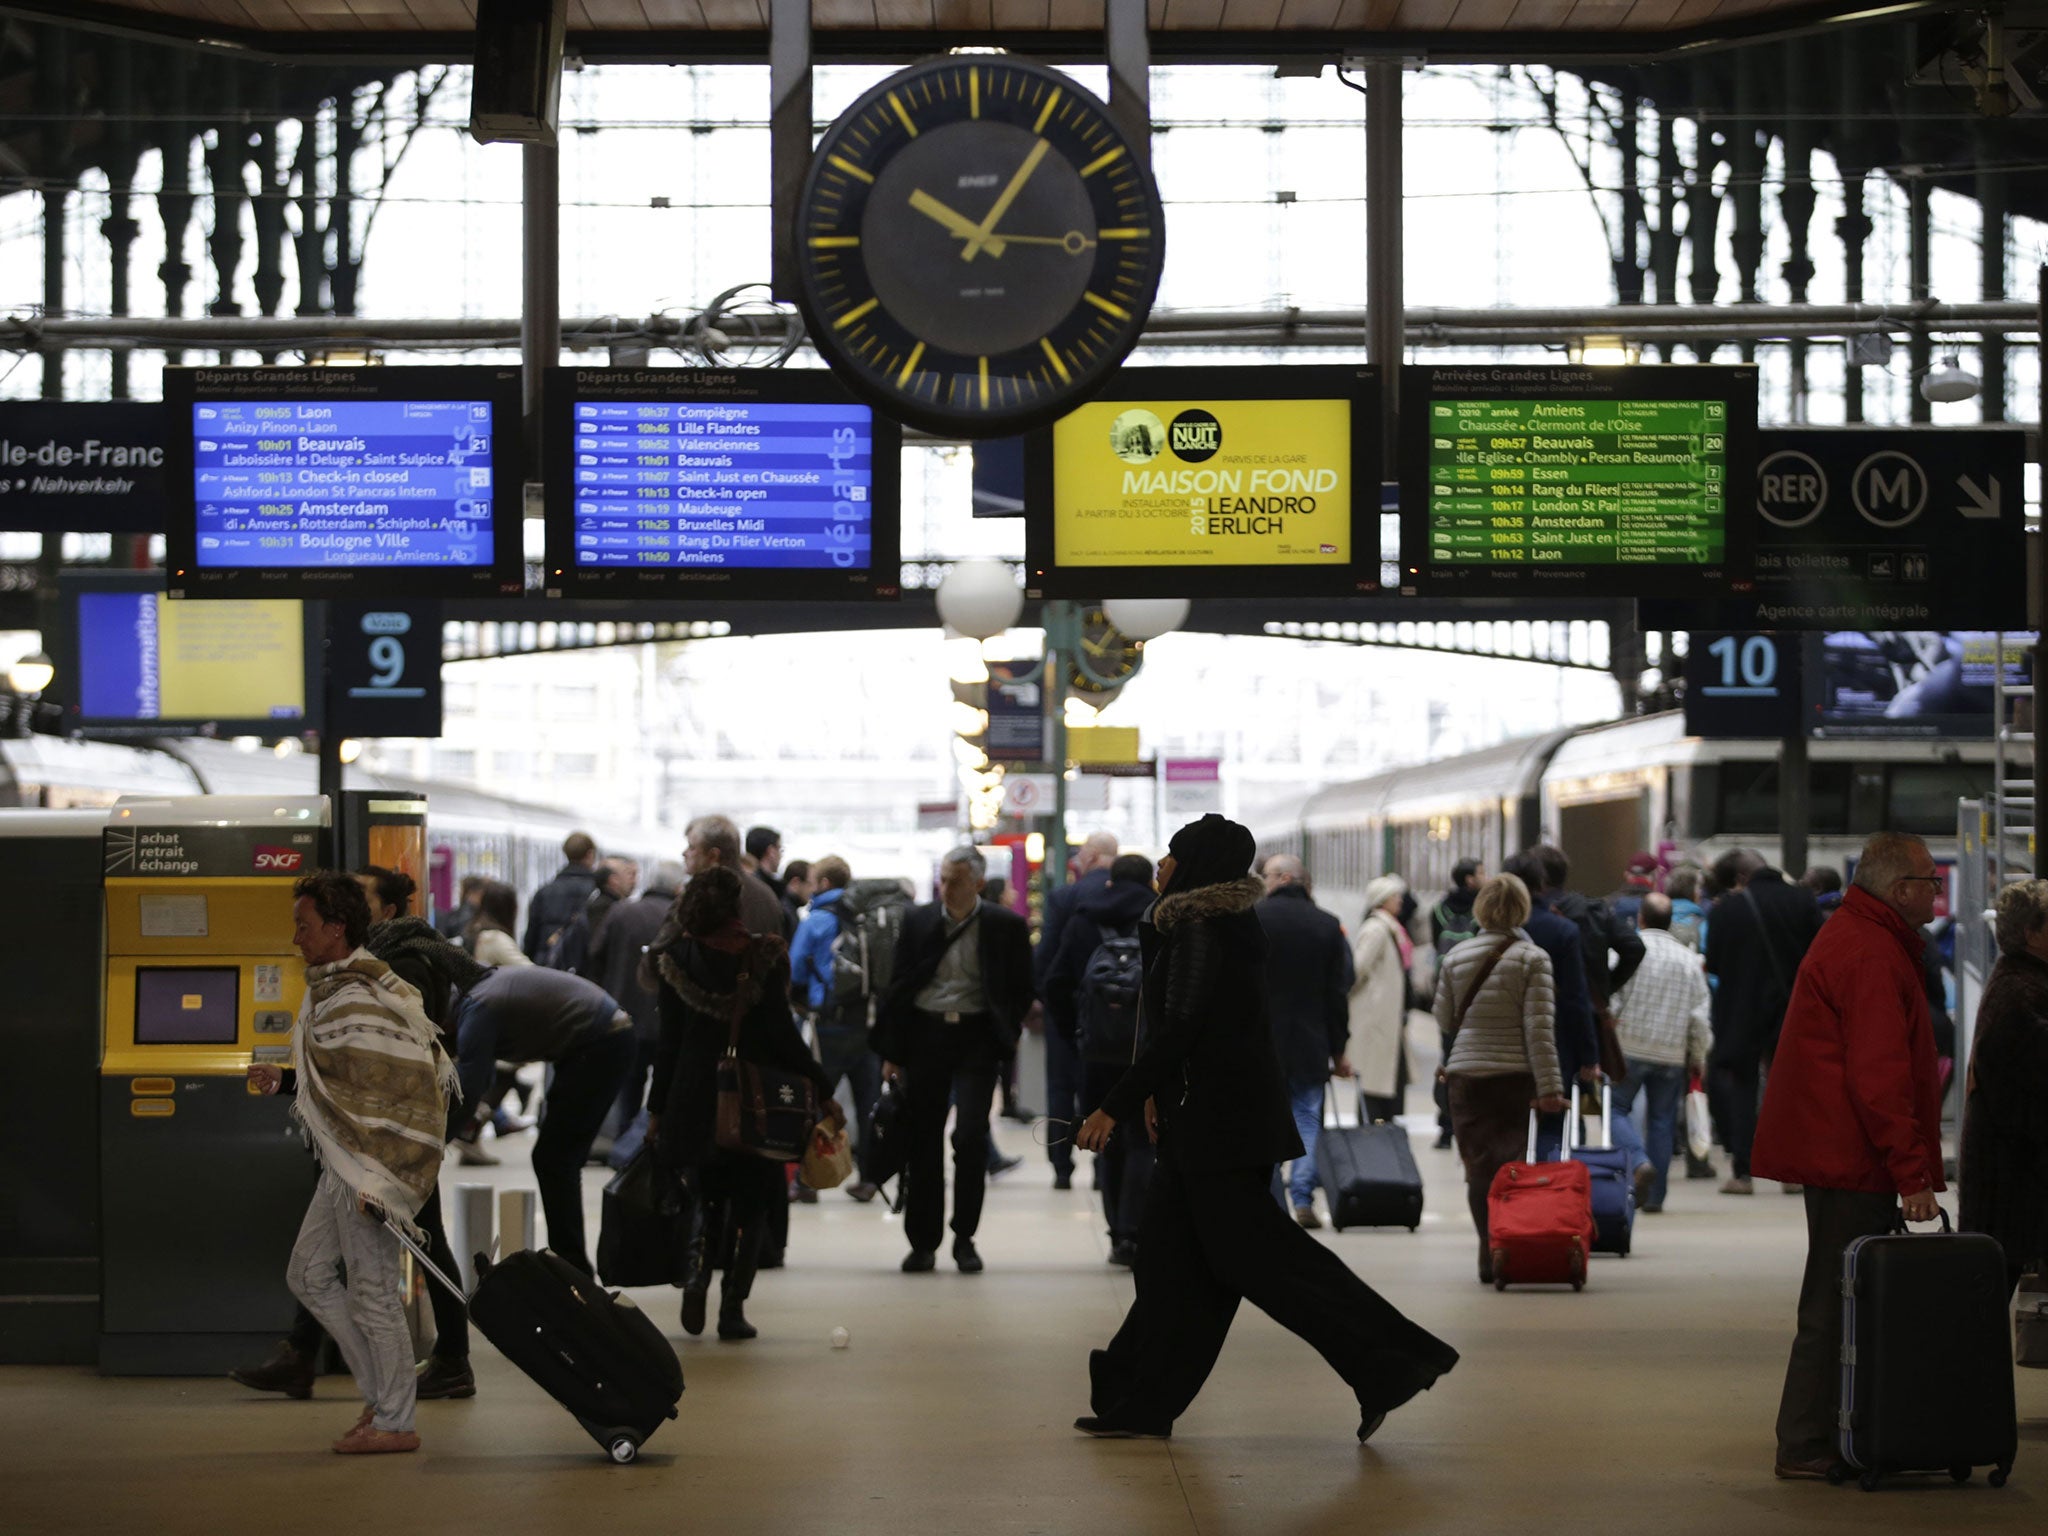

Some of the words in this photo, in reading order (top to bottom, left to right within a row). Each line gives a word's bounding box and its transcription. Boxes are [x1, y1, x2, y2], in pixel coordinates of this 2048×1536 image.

[196, 370, 249, 384] Départs
[252, 370, 309, 382] Grandes
[313, 370, 356, 384] Lignes
[576, 371, 630, 384] Départs
[634, 371, 689, 383] Grandes
[694, 372, 736, 386] Lignes
[1432, 370, 1487, 381] Arrivées
[1491, 370, 1546, 381] Grandes
[1551, 370, 1593, 383] Lignes
[255, 407, 291, 419] 09h55
[297, 406, 332, 419] Laon
[472, 406, 487, 418] 18
[637, 407, 670, 418] 10h37
[677, 406, 749, 421] Compiègne
[1490, 408, 1520, 417] arrivé
[1532, 404, 1585, 417] Amiens
[1707, 405, 1722, 416] 19
[225, 421, 259, 436] Anizy
[261, 421, 297, 433] Pinon
[307, 421, 337, 433] Laon
[677, 422, 705, 435] Lille
[706, 422, 760, 435] Flandres
[1459, 419, 1518, 431] Chaussée
[1527, 419, 1586, 431] Clermont
[1589, 420, 1604, 431] de
[1607, 419, 1642, 431] l'Oise
[1173, 427, 1218, 442] NUIT
[257, 440, 291, 451] 10h01
[297, 436, 366, 451] Beauvais
[472, 439, 487, 450] 21
[678, 438, 760, 451] Valenciennes
[1173, 441, 1218, 450] BLANCHE
[1490, 438, 1527, 449] 09h57
[1533, 436, 1594, 449] Beauvais
[1706, 438, 1721, 449] 20
[224, 454, 293, 466] Laboissière
[296, 454, 308, 465] le
[311, 454, 354, 468] Deluge
[363, 453, 396, 465] Saint
[398, 453, 444, 467] Sulpice
[446, 453, 464, 465] Au
[637, 455, 670, 466] 11h01
[678, 454, 733, 467] Beauvais
[1222, 455, 1253, 464] PARVIS
[1255, 455, 1267, 463] DE
[1269, 455, 1281, 463] LA
[1283, 454, 1308, 464] GARE
[1478, 451, 1514, 465] Eglise
[1524, 452, 1578, 465] Chambly
[1589, 452, 1630, 463] Persan
[1633, 452, 1697, 463] Beaumont
[258, 472, 293, 483] 10h13
[298, 470, 360, 483] Check-in
[363, 470, 409, 483] closed
[637, 471, 670, 482] 11h07
[678, 470, 710, 482] Saint
[712, 471, 741, 483] Just
[742, 473, 758, 483] en
[760, 470, 820, 483] Chaussée
[1490, 469, 1525, 480] 09h59
[1533, 468, 1568, 480] Essen
[1711, 469, 1717, 477] 7
[30, 476, 136, 494] Nahverkehr
[1122, 470, 1242, 495] MAISON
[1249, 468, 1338, 494] FOND
[223, 485, 272, 498] Ashford
[282, 485, 329, 497] London
[331, 486, 346, 497] St
[348, 485, 396, 497] Pancras
[399, 486, 436, 497] Intern
[637, 487, 670, 498] 11h13
[677, 486, 733, 499] Check-in
[735, 488, 767, 501] open
[1490, 485, 1525, 495] 10h14
[1533, 484, 1564, 498] Rang
[1566, 484, 1583, 496] du
[1585, 484, 1618, 496] Fliers
[1708, 485, 1718, 493] 14
[1762, 475, 1818, 503] RER
[1870, 468, 1911, 510] M
[824, 427, 864, 567] départs
[1123, 498, 1190, 508] INSTALLATION
[258, 504, 294, 515] 10h25
[298, 501, 389, 515] Amsterdam
[474, 504, 488, 514] 11
[678, 503, 743, 518] Maubeuge
[1208, 496, 1317, 515] LEANDRO
[1490, 501, 1525, 511] 10h17
[1532, 500, 1578, 511] London
[1582, 500, 1595, 512] St
[1085, 509, 1117, 518] PARTIR
[1118, 509, 1133, 518] DU
[1135, 509, 1141, 518] 3
[1143, 508, 1189, 518] OCTOBRE
[1190, 497, 1205, 536] 2015
[247, 517, 290, 530] Anvers
[299, 517, 367, 530] Rotterdam
[375, 517, 430, 531] Schiphol
[637, 519, 670, 530] 11h25
[678, 518, 735, 531] Bruxelles
[737, 519, 765, 531] Midi
[1208, 517, 1283, 535] ERLICH
[1490, 517, 1525, 528] 10h35
[1532, 516, 1605, 528] Amsterdam
[259, 536, 294, 547] 10h31
[300, 533, 372, 550] Boulogne
[375, 533, 410, 547] Ville
[678, 535, 710, 549] Rang
[712, 535, 731, 547] Du
[733, 535, 761, 547] Flier
[763, 536, 806, 548] Verton
[1490, 533, 1525, 544] 10h53
[1532, 532, 1564, 544] Saint
[1566, 532, 1593, 544] Just
[1596, 534, 1612, 543] en
[325, 550, 385, 565] Longueau
[395, 550, 440, 561] Amiens
[677, 551, 724, 563] Amiens
[1490, 549, 1525, 560] 11h12
[1532, 548, 1562, 560] Laon
[1786, 553, 1849, 568] toilettes
[1533, 569, 1586, 578] Provenance
[1702, 569, 1722, 578] voie
[1757, 604, 1814, 620] Agence
[1818, 605, 1857, 618] carte
[1861, 603, 1930, 620] intégrale
[368, 636, 405, 688] 9
[1708, 635, 1778, 687] 10
[141, 833, 179, 845] achat
[141, 845, 185, 858] retrait
[140, 858, 199, 873] échange
[255, 853, 302, 869] SNCF
